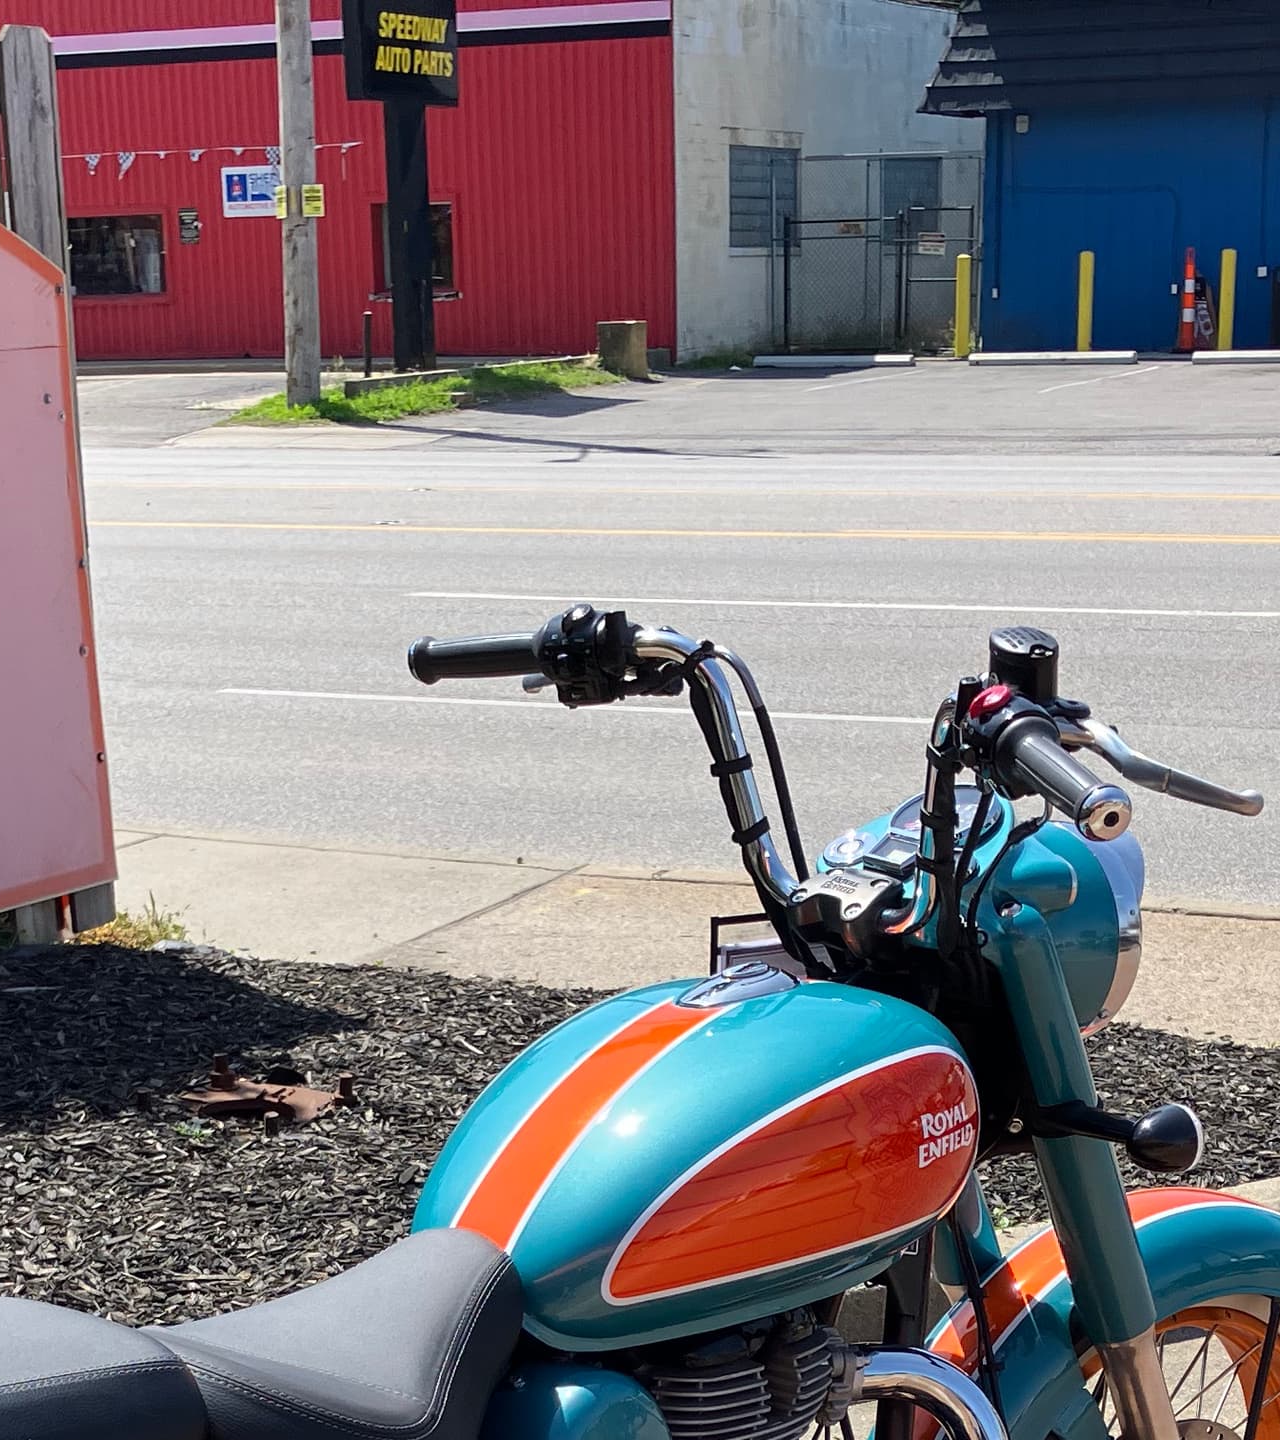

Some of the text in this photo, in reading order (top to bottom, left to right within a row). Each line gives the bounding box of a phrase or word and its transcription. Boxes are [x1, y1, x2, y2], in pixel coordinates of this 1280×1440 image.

[378, 11, 449, 44] SPEEDWAY
[375, 45, 454, 77] AUTO PARTS
[920, 1102, 968, 1139] ROYAL
[918, 1123, 974, 1168] ENFIELD
